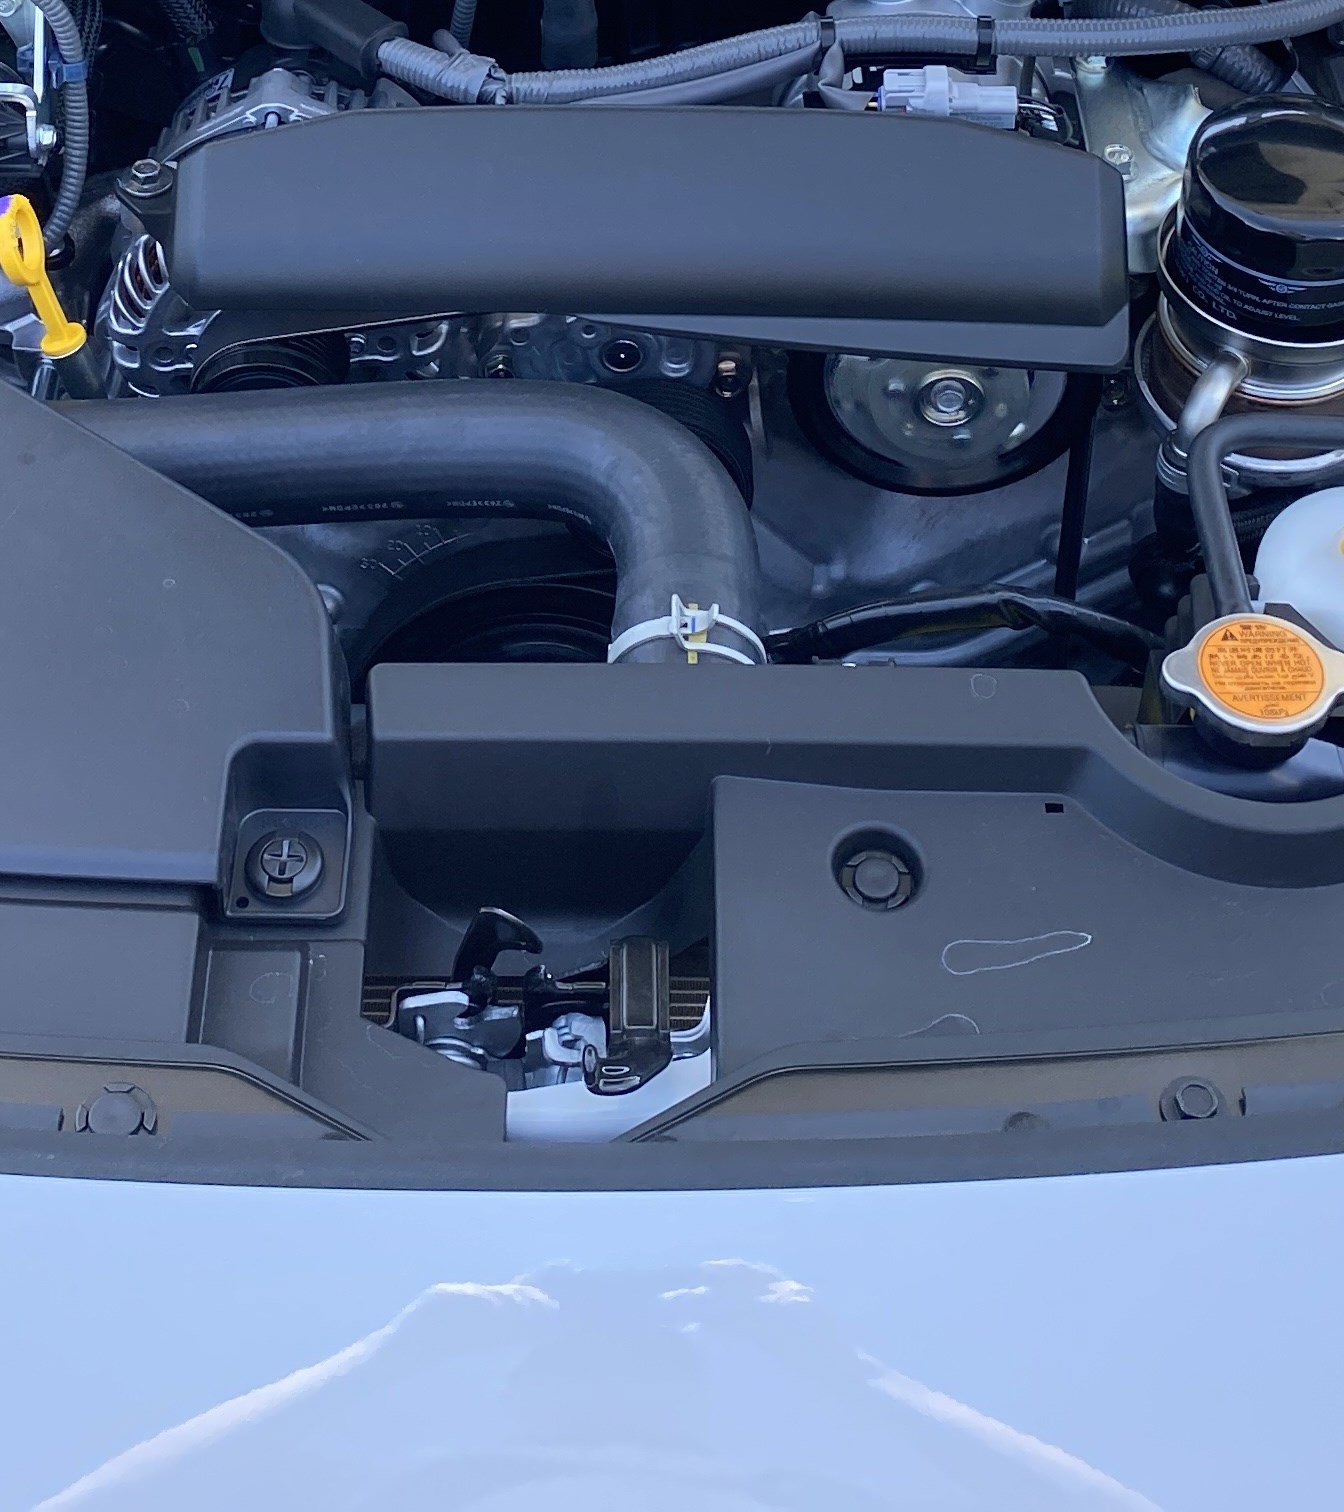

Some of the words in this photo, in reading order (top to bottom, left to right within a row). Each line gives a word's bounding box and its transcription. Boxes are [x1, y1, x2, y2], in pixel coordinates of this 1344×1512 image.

[1262, 299, 1288, 308] AFTER
[1239, 630, 1288, 638] WARNING
[1232, 693, 1306, 702] AVERTISSEMENT
